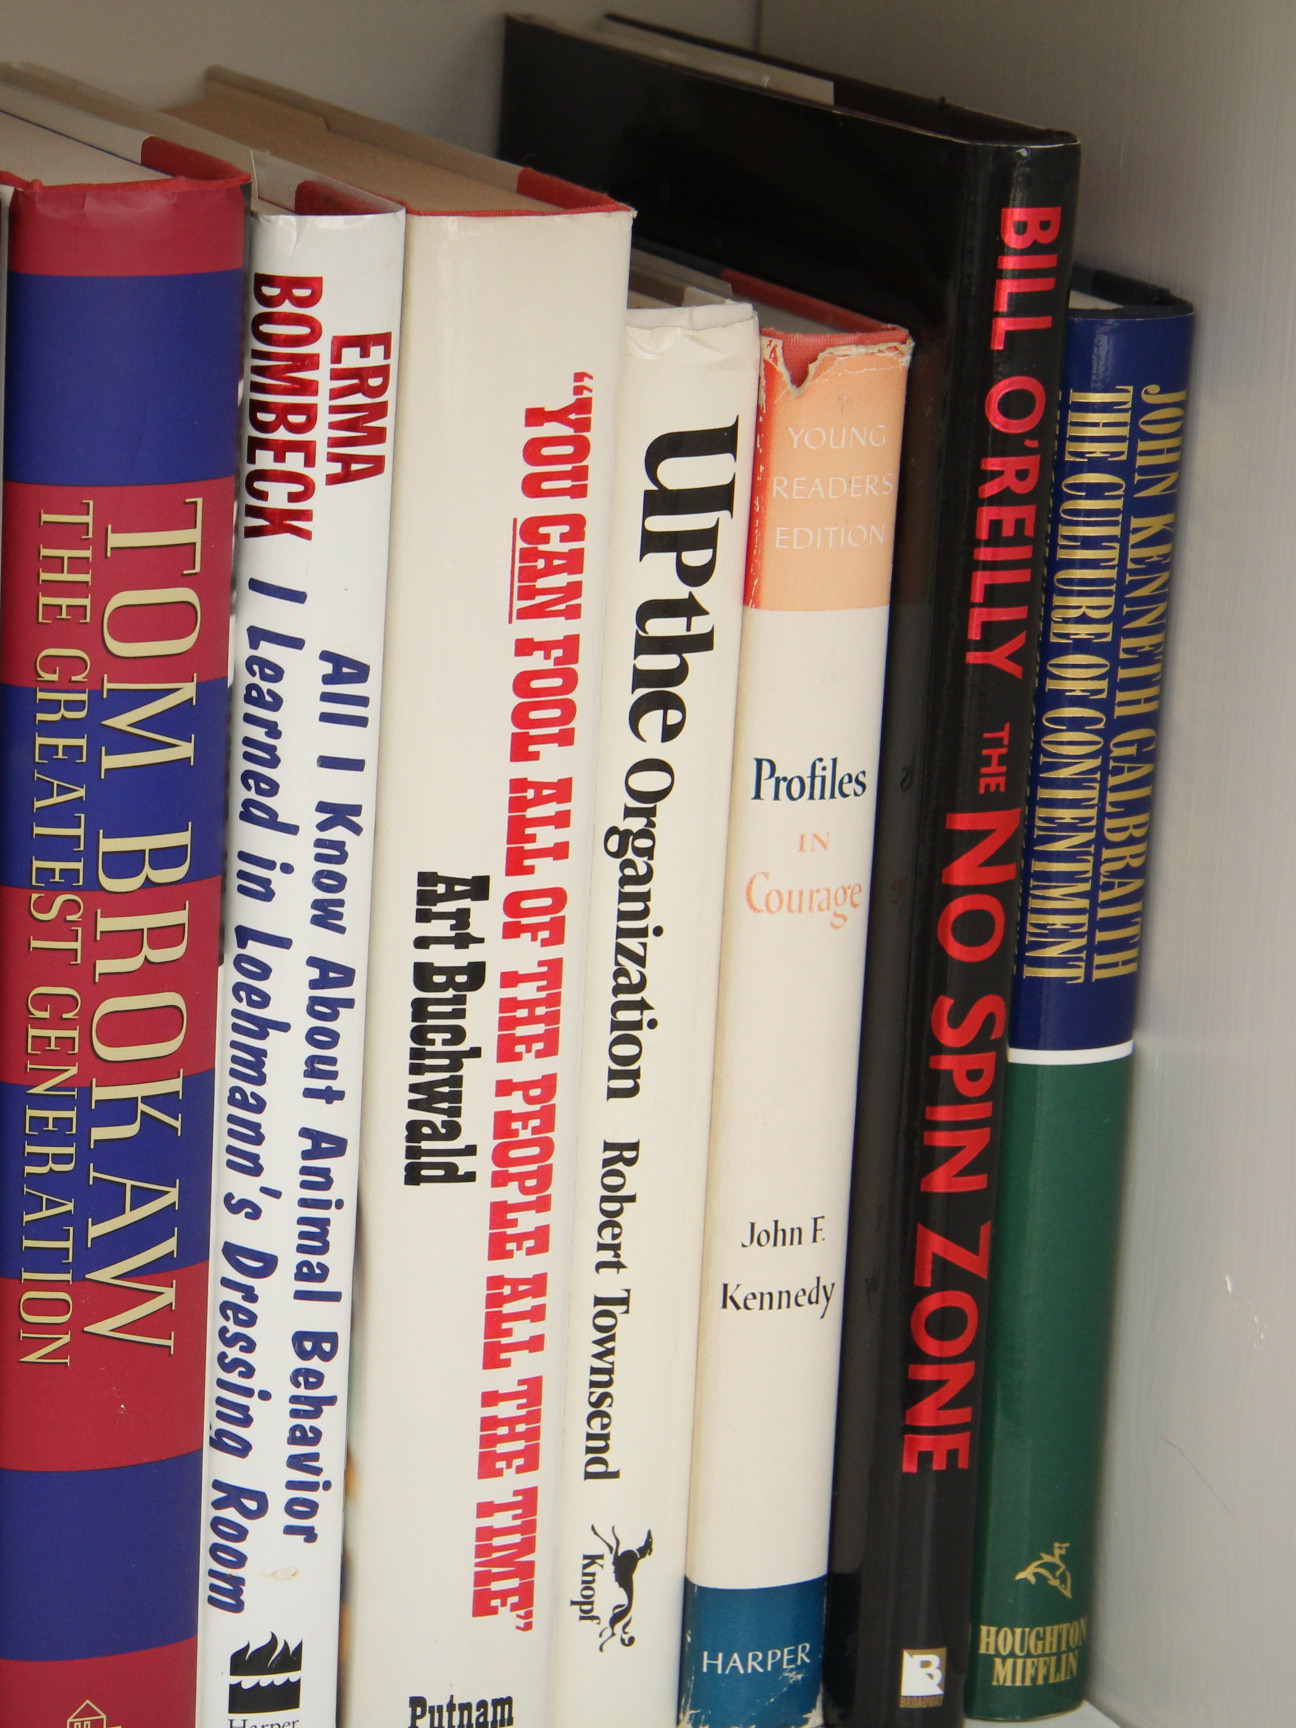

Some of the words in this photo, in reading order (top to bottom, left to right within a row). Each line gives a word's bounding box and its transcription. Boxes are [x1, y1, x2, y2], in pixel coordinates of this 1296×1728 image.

[990, 206, 1062, 350] BILL
[243, 272, 324, 542] BOMBECK
[324, 331, 393, 487] ERMA
[519, 371, 594, 499] "YOU
[788, 424, 887, 451] YOUNG
[1064, 385, 1133, 462] THE
[1132, 384, 1187, 499] JOHN
[771, 472, 894, 500] READERS
[774, 523, 886, 550] EDITION
[965, 375, 1046, 680] O'REILLY
[37, 499, 94, 626] THE
[247, 577, 308, 605] I
[515, 512, 587, 622] CAN
[1050, 472, 1126, 644] CULTURE
[1113, 515, 1176, 719] KENNETH
[101, 497, 204, 779] TOM
[318, 649, 371, 728] All
[509, 634, 581, 763] FOOL
[627, 588, 714, 744] the
[1044, 652, 1111, 700] OF
[238, 624, 306, 836] Learned
[316, 754, 366, 772] I
[750, 756, 867, 802] Profiles
[978, 723, 1010, 794] THE
[28, 647, 92, 966] GREATEST
[309, 800, 364, 935] Know
[504, 776, 573, 877] ALL
[797, 831, 831, 853] IN
[1023, 706, 1107, 984] CONTENTMENT
[1092, 727, 1158, 982] GALBRAITH
[236, 850, 295, 903] in
[413, 871, 491, 951] Art
[501, 886, 568, 948] OF
[603, 757, 676, 1101] Organization
[745, 871, 864, 930] Courage
[936, 808, 1022, 963] NO
[223, 924, 293, 1222] Loehmann's
[302, 955, 356, 1105] About
[403, 960, 487, 1187] Buchwald
[496, 957, 564, 1064] THE
[83, 820, 193, 1355] BROKAW
[920, 993, 1007, 1193] SPIN
[18, 984, 83, 1368] GENERATION
[293, 1126, 349, 1303] Animal
[487, 1073, 558, 1263] PEOPLE
[595, 1139, 641, 1275] Robert
[740, 1218, 803, 1249] John
[810, 1215, 826, 1244] F.
[209, 1240, 279, 1460] Dressing
[482, 1271, 548, 1370] ALL
[719, 1276, 836, 1320] Kennedy
[901, 1220, 992, 1474] ZONE
[282, 1330, 340, 1544] Behavior
[477, 1375, 543, 1482] THE
[582, 1289, 632, 1483] Townsend
[207, 1479, 269, 1615] Room
[471, 1485, 539, 1632] TIME"
[570, 1553, 605, 1625] Knopf
[701, 1642, 811, 1675] HARPER
[978, 1616, 1088, 1656] HOUGHTON
[991, 1650, 1079, 1687] MIFFLIN
[407, 1694, 514, 1728] Putnam
